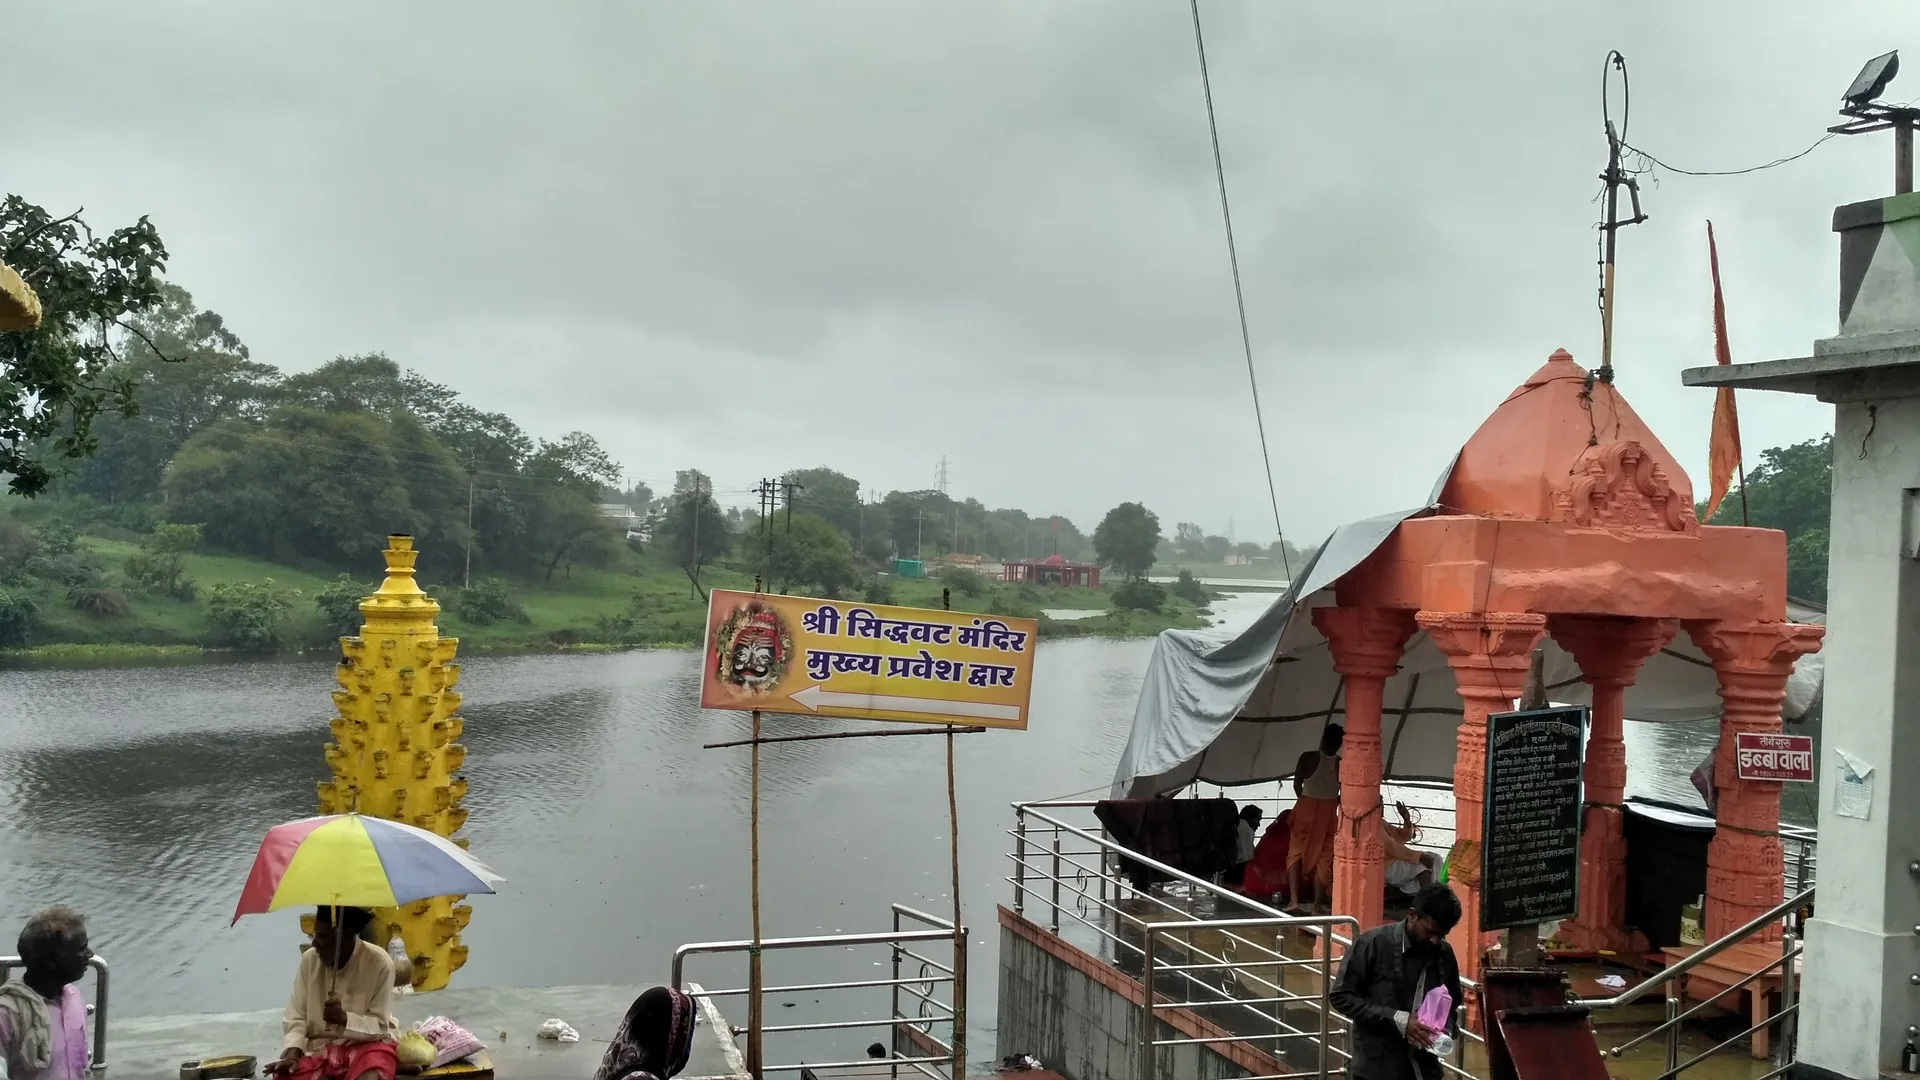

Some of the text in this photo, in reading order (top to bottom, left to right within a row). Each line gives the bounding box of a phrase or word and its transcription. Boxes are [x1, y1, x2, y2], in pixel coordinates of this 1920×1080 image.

[803, 606, 1027, 652] श्री सिद्धवट मंदिर
[806, 650, 1017, 688] मुख्य प्रवेश द्वार
